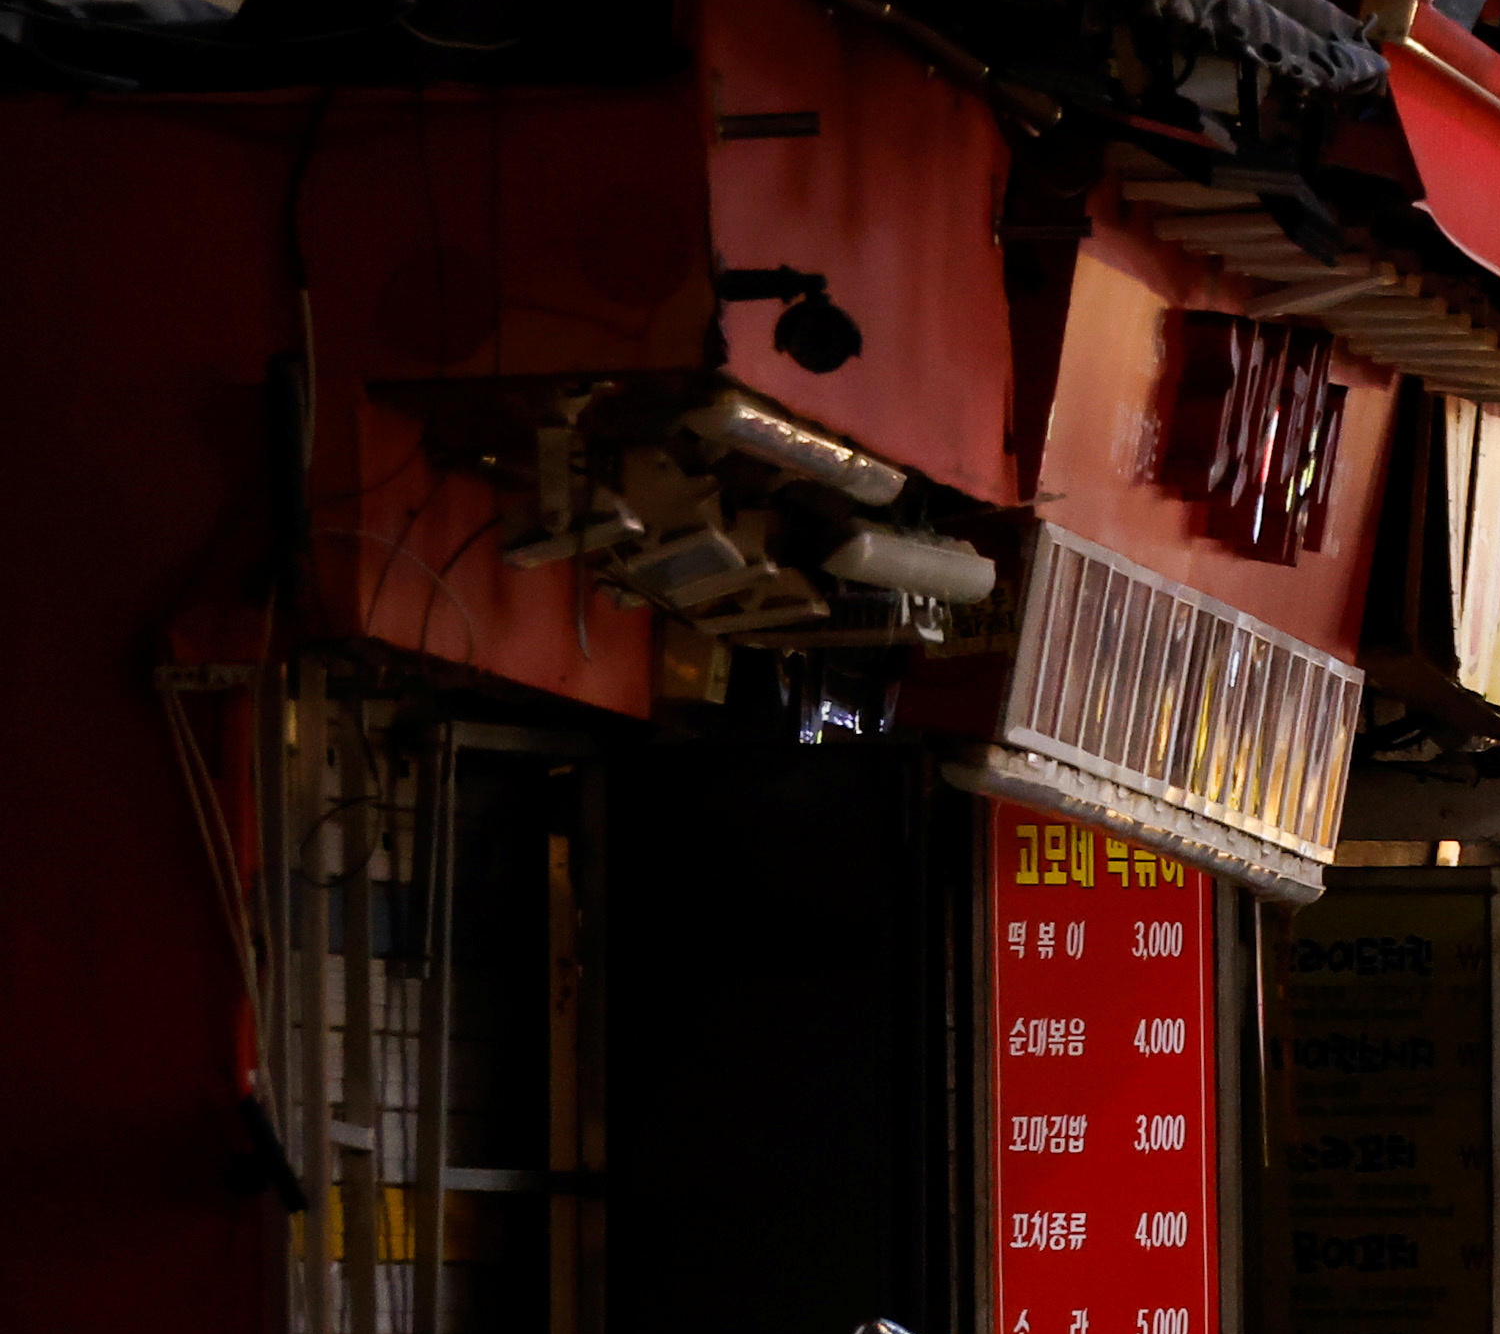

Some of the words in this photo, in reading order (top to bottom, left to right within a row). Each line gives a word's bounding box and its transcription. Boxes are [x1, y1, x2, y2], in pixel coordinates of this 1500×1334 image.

[1130, 922, 1183, 958] 3,000
[1008, 1016, 1086, 1058] 순대볶음
[1132, 1017, 1185, 1056] 4,000
[1008, 1114, 1088, 1154] 꼬마김밥
[1132, 1115, 1185, 1152] 3,000
[1010, 1212, 1088, 1252] 꼬치종류
[1134, 1213, 1188, 1250] 4,000
